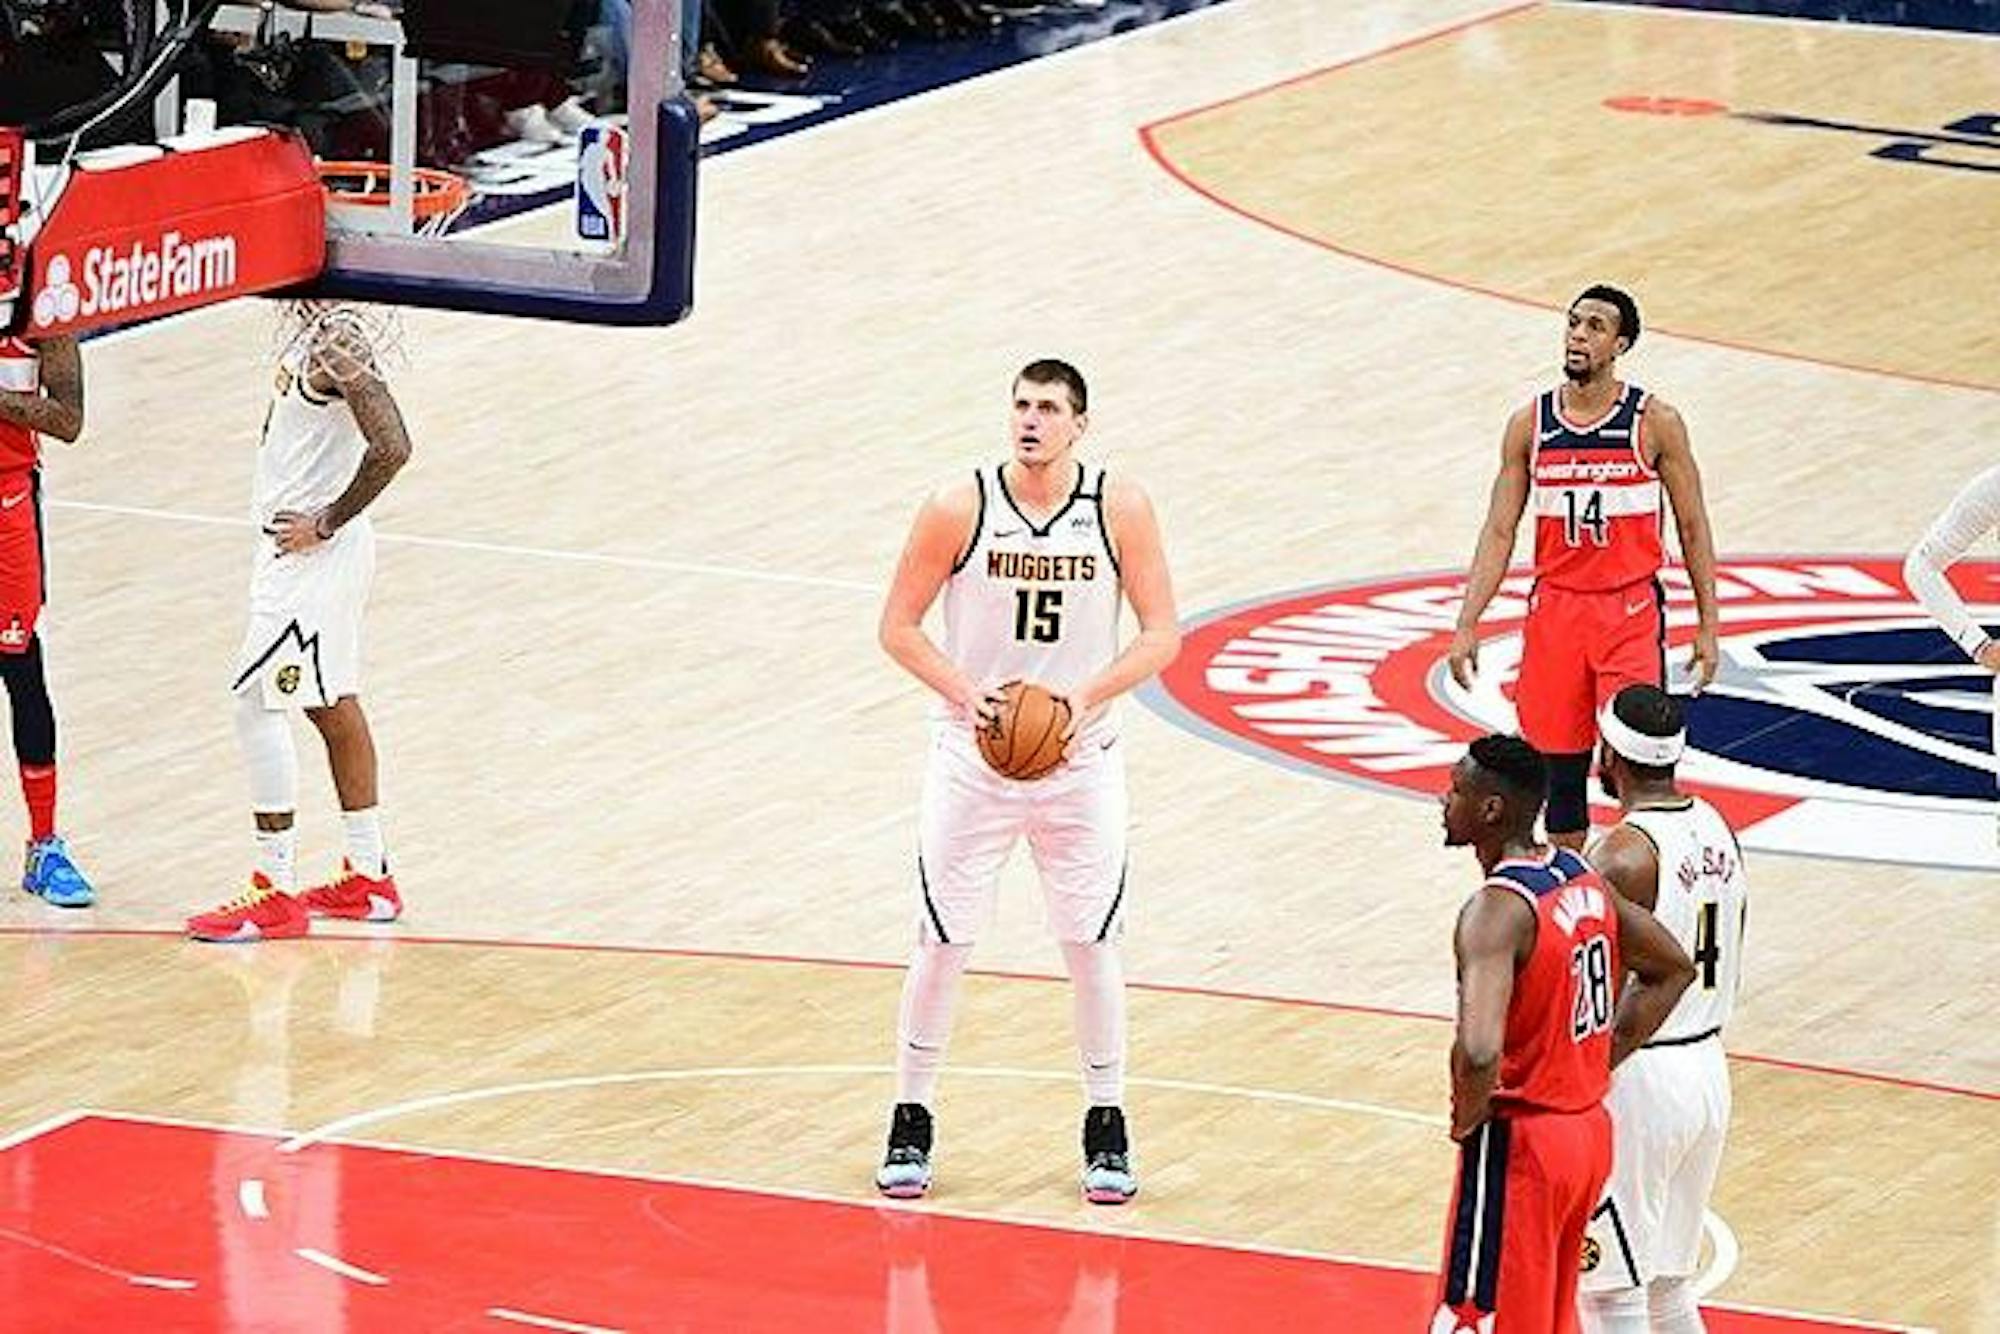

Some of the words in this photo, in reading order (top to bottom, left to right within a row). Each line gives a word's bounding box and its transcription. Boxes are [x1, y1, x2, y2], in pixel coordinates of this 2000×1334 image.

[1563, 487, 1609, 547] 14
[986, 550, 1097, 582] NUGGETS
[1015, 589, 1063, 643] 15
[1694, 902, 1720, 991] 4
[1571, 935, 1613, 1044] 28
